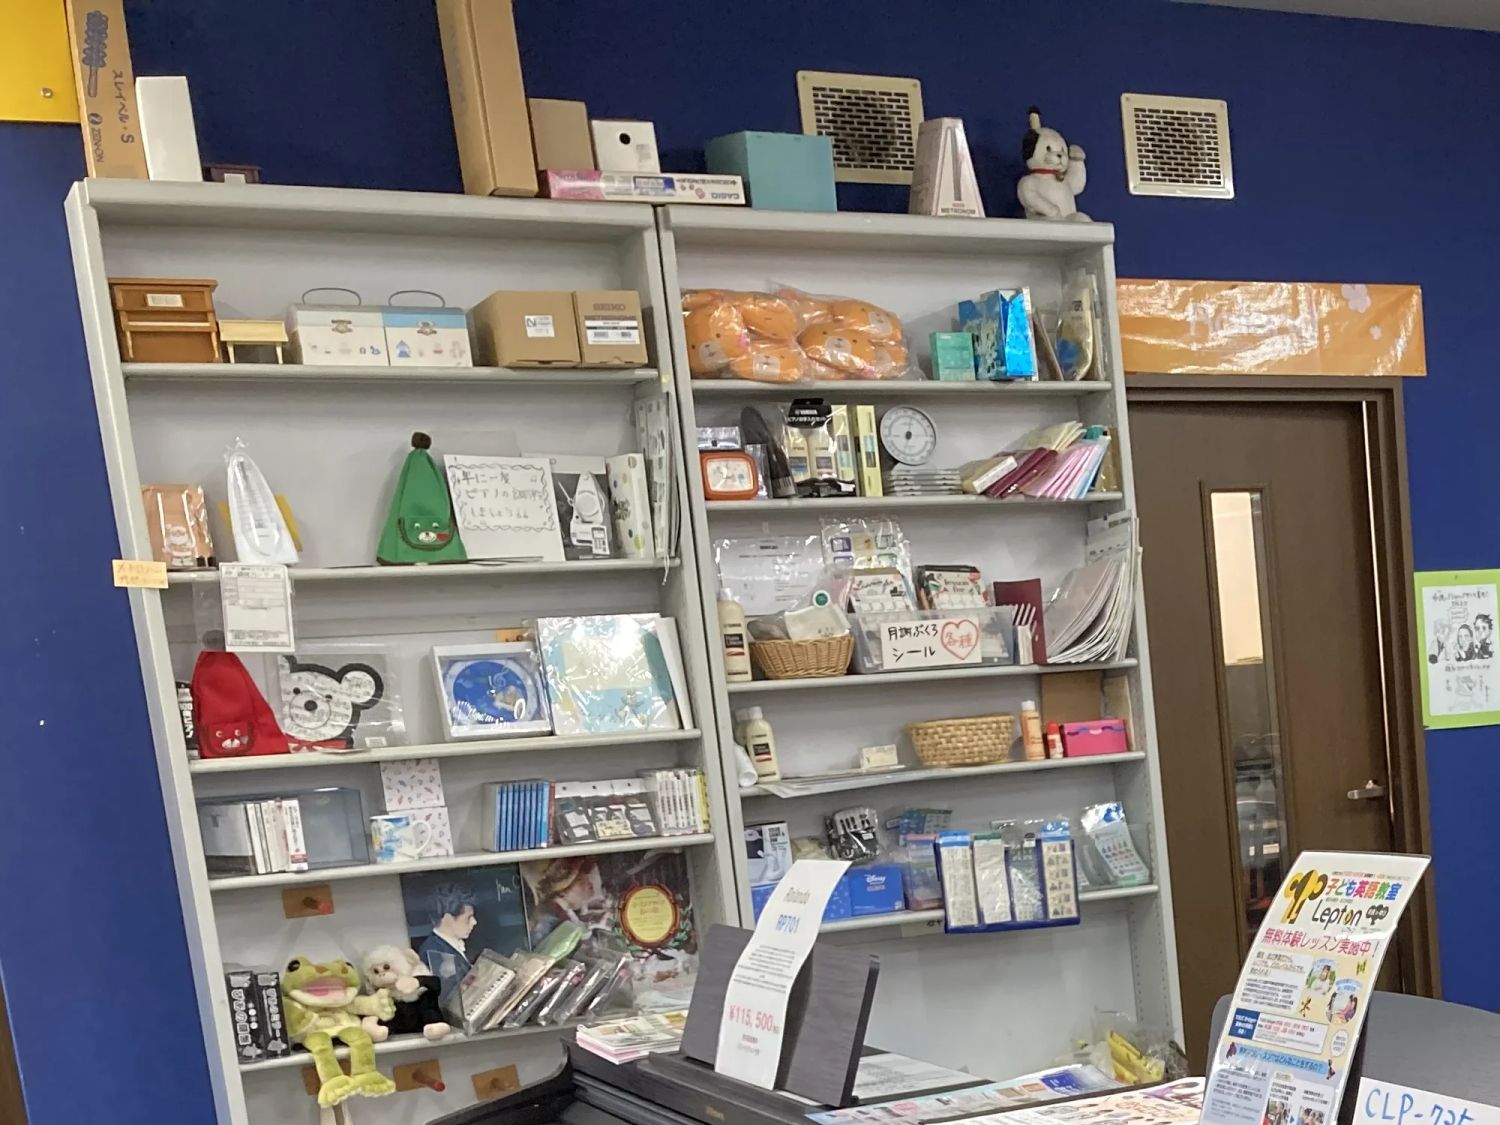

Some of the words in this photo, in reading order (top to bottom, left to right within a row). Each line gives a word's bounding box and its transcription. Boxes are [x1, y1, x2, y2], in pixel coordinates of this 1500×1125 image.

[887, 623, 939, 642] 月謝ぶくろ
[891, 646, 936, 663] シール
[1325, 877, 1404, 902] 子ども英語教室
[1311, 898, 1363, 931] Lepton
